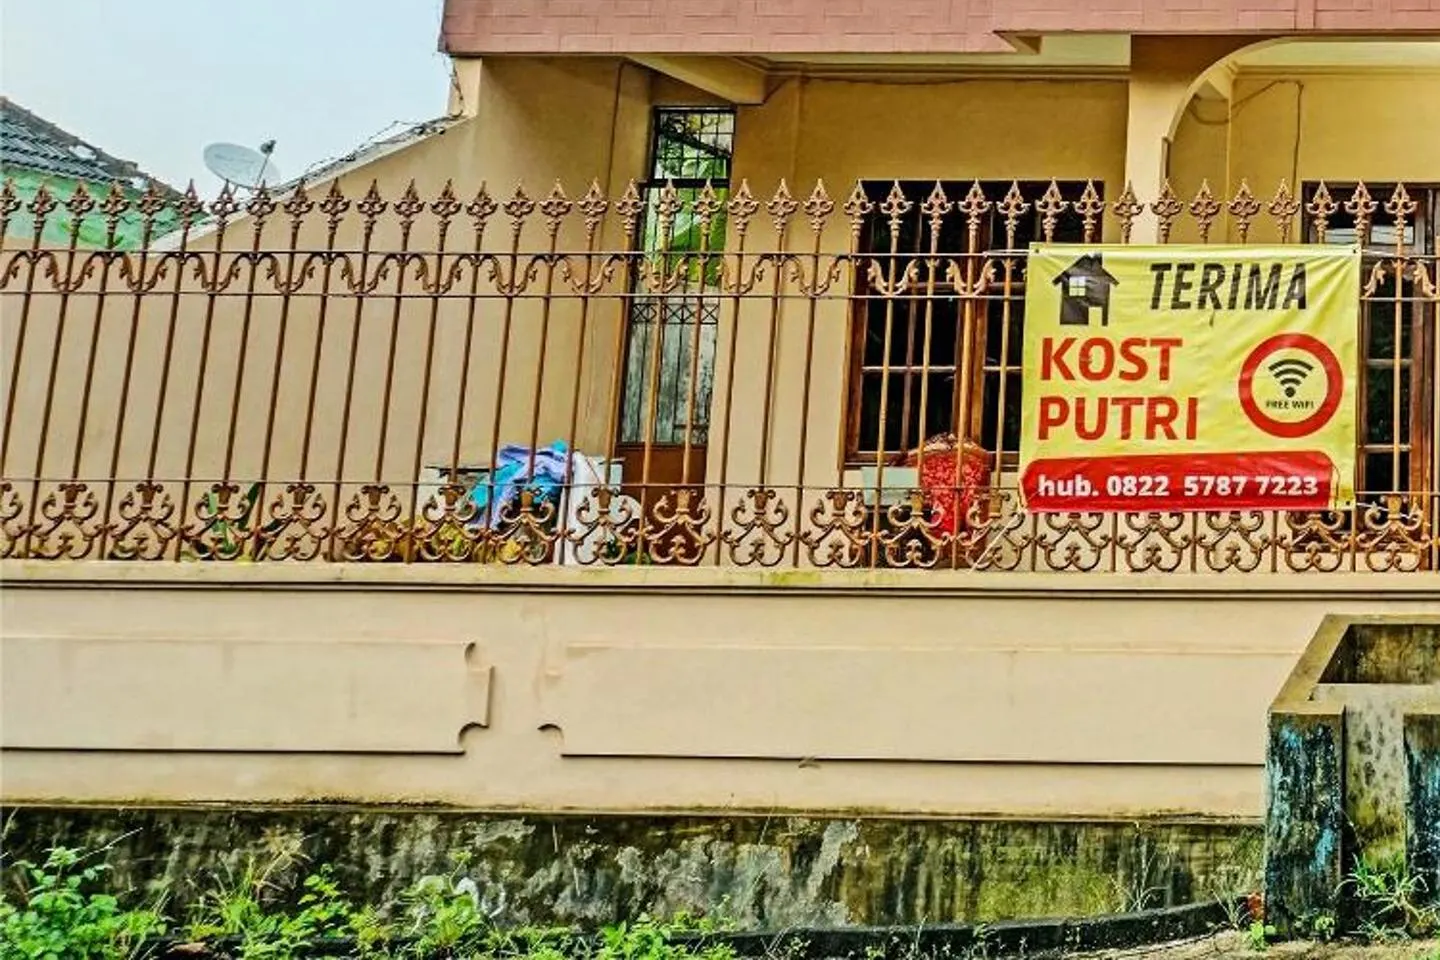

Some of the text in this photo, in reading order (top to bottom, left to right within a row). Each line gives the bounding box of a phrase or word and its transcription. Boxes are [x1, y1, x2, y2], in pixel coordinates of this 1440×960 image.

[1150, 262, 1308, 310] TERIMA
[1040, 337, 1183, 382] KOST
[1037, 396, 1199, 441] PUTRI
[1266, 400, 1289, 410] FREE
[1038, 473, 1319, 497] hub. 0822 5787 7223
